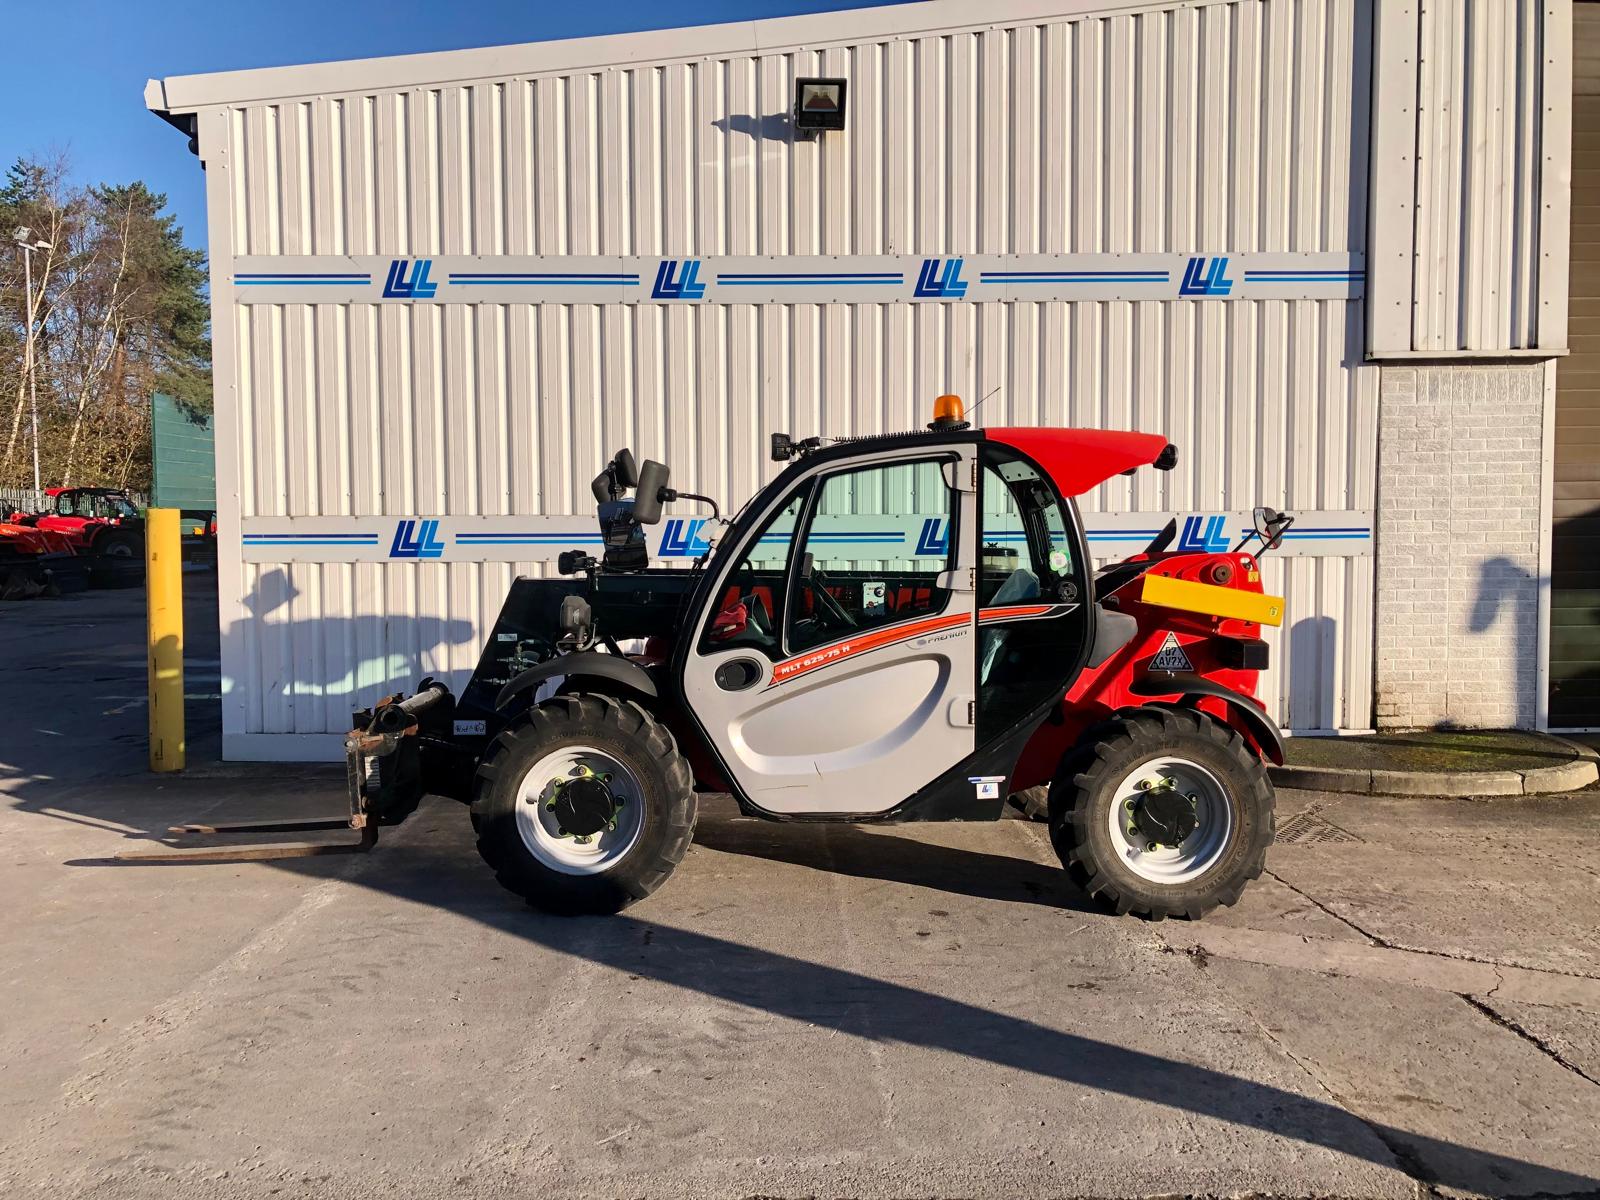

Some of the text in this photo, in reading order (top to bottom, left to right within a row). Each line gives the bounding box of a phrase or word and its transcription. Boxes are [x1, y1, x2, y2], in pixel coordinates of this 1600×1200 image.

[781, 645, 851, 675] MLT 625-75 H
[1158, 656, 1184, 667] AV7X
